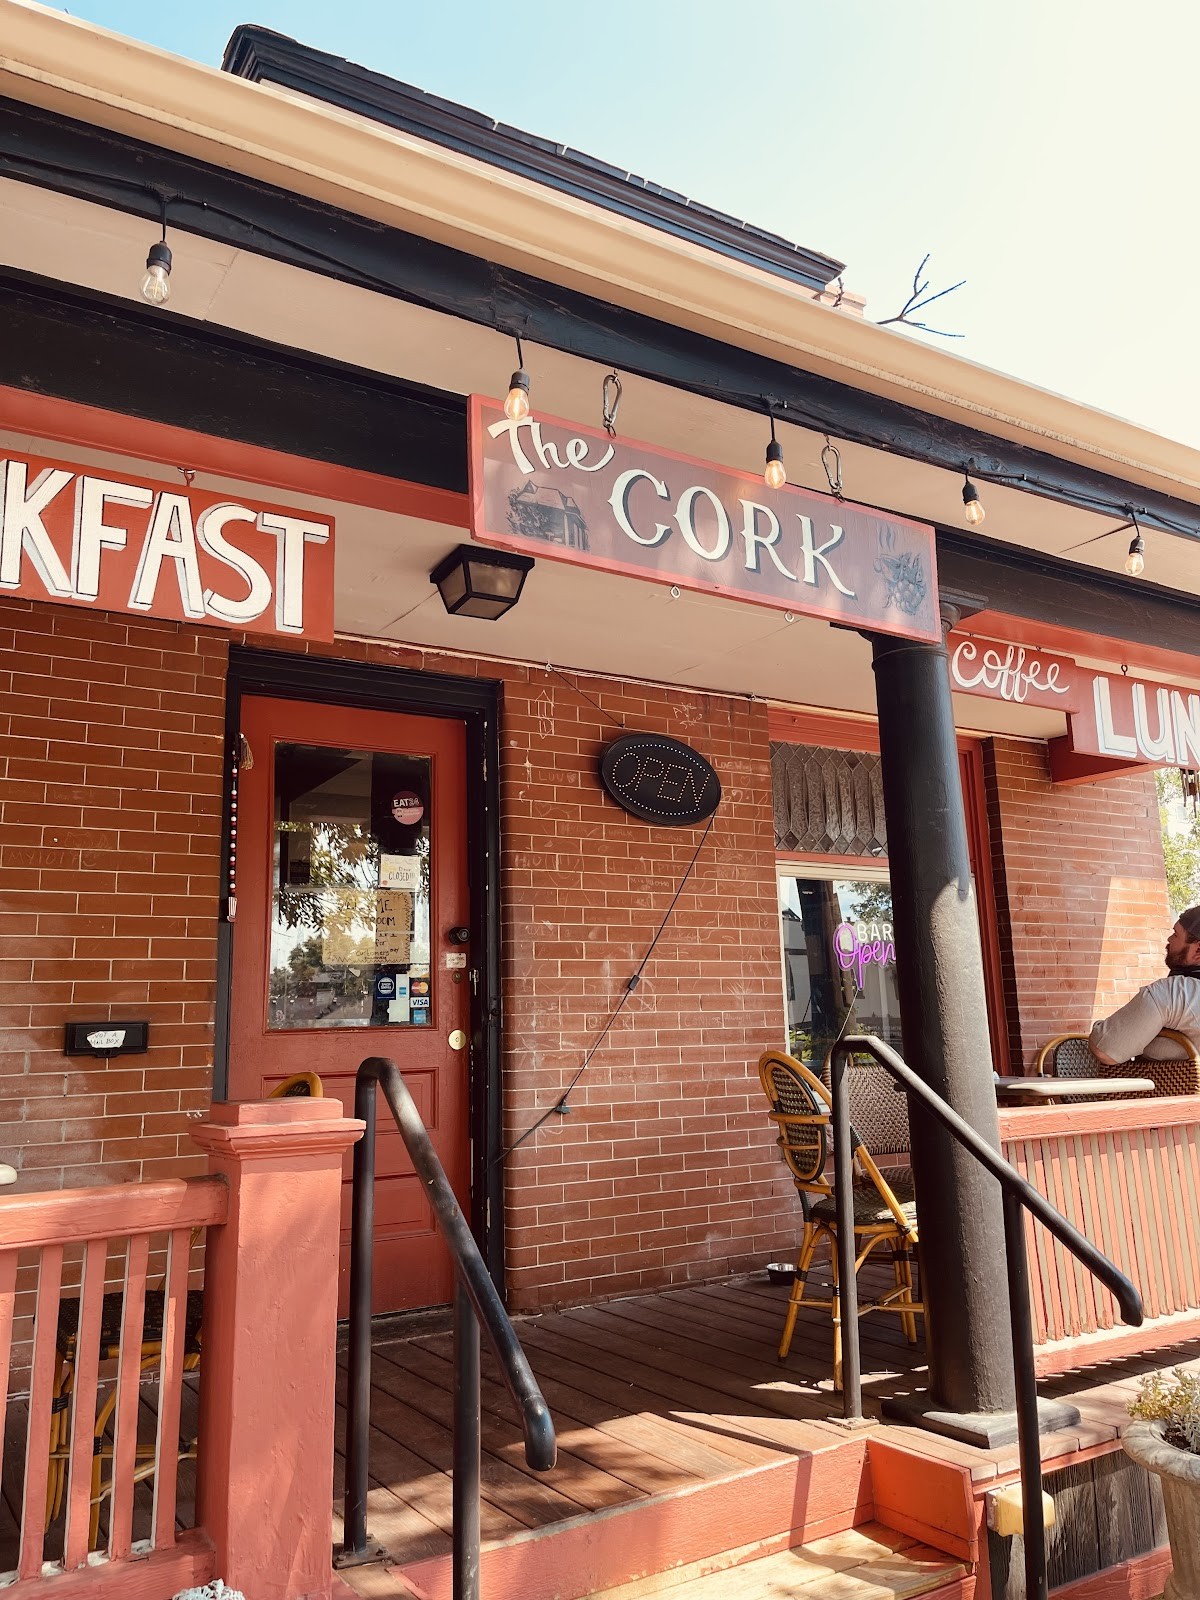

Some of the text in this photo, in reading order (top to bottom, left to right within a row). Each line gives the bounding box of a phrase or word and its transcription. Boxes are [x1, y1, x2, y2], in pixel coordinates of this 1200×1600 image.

[487, 417, 615, 475] The
[607, 468, 859, 601] CORK
[611, 751, 712, 808] OPEN
[835, 924, 896, 989] Open
[857, 923, 893, 942] BAR
